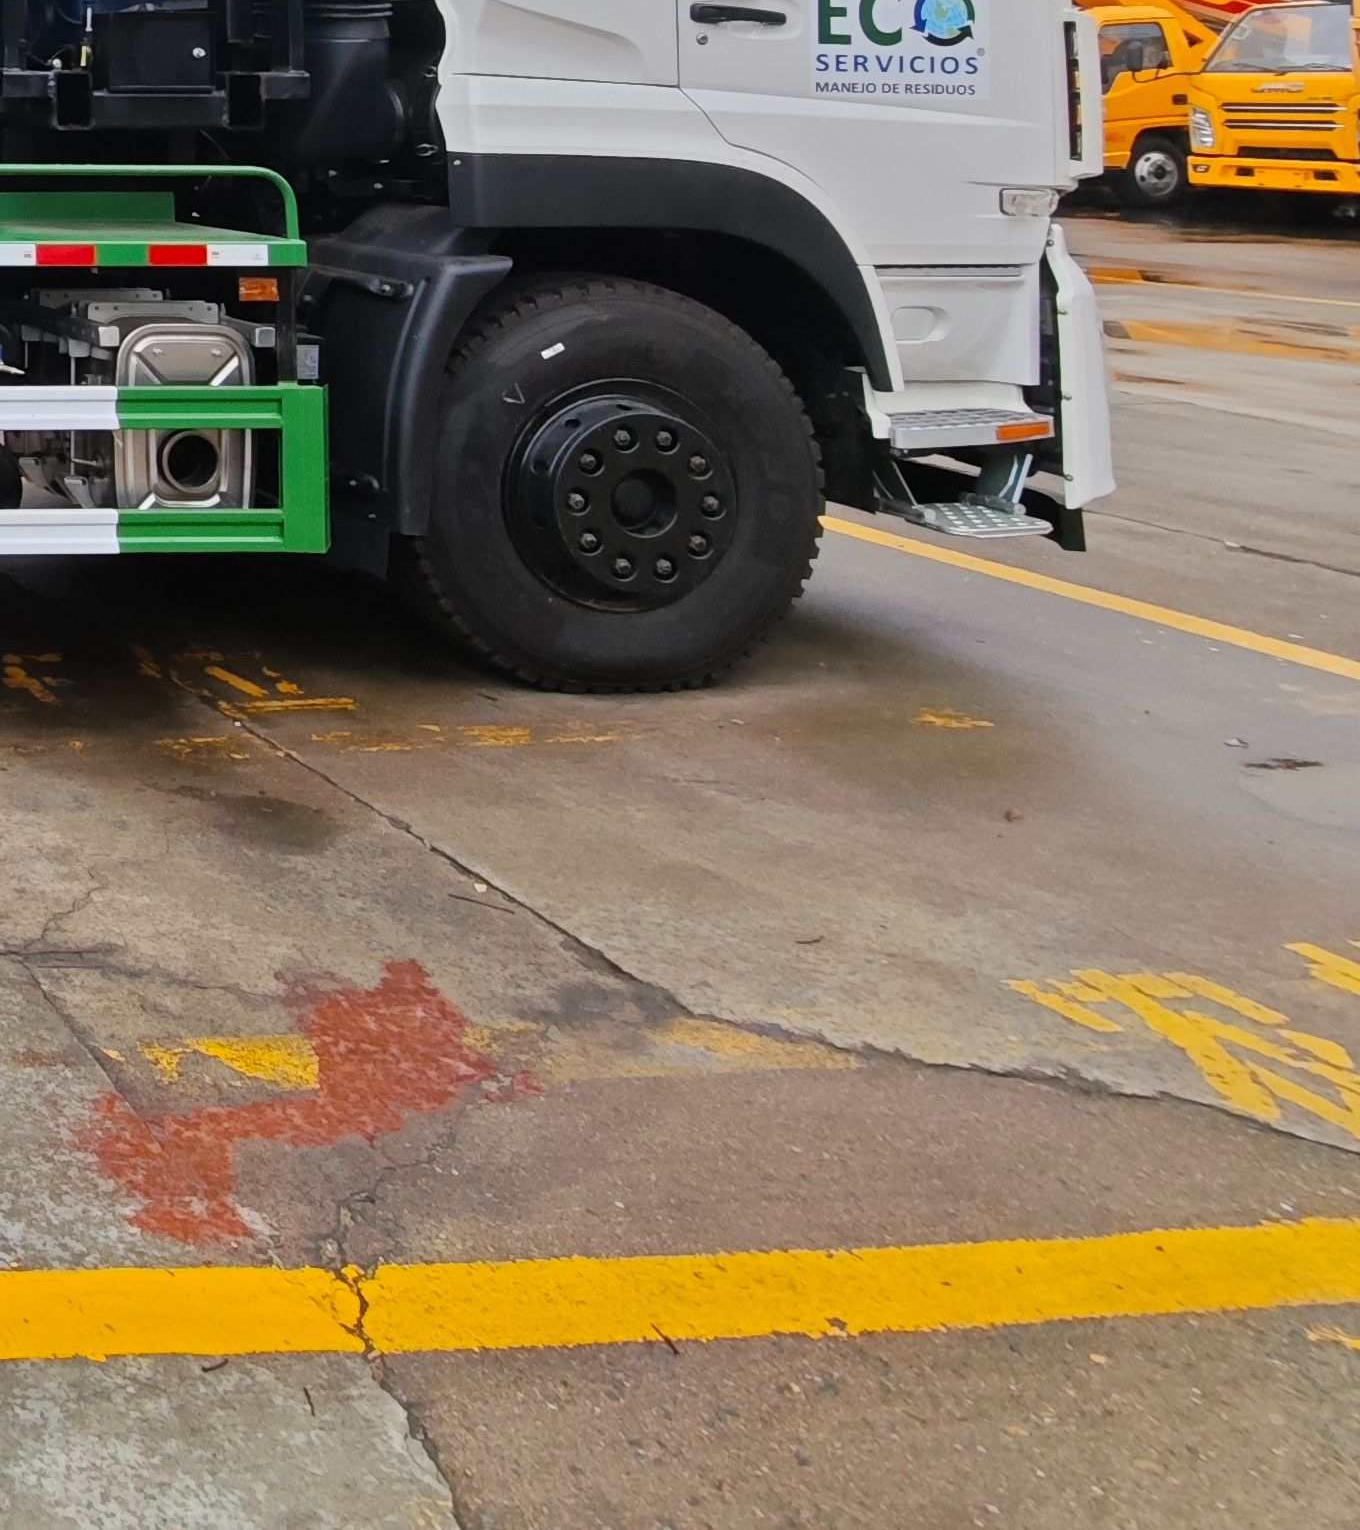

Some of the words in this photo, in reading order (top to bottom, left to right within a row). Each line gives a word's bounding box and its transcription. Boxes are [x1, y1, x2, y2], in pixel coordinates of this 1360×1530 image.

[815, 81, 878, 95] MANEJO
[881, 82, 900, 95] DE
[904, 83, 977, 97] RESIDUOS
